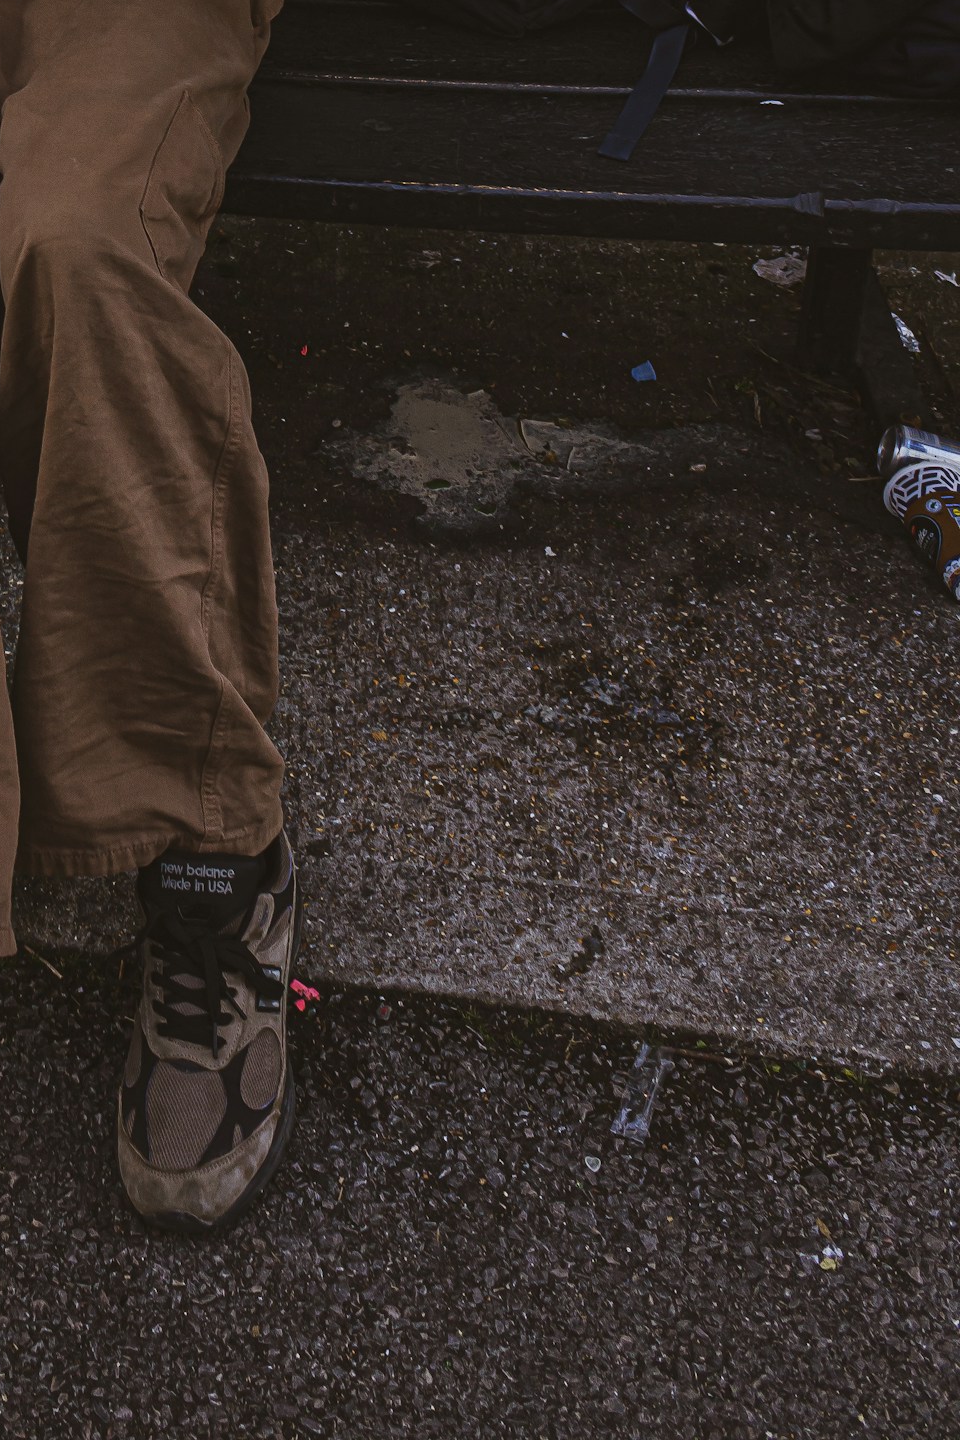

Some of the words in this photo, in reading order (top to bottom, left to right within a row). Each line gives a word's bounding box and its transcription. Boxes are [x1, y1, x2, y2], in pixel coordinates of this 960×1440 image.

[160, 862, 183, 876] new
[187, 863, 235, 879] balance
[161, 875, 191, 891] Made
[208, 880, 233, 894] USA
